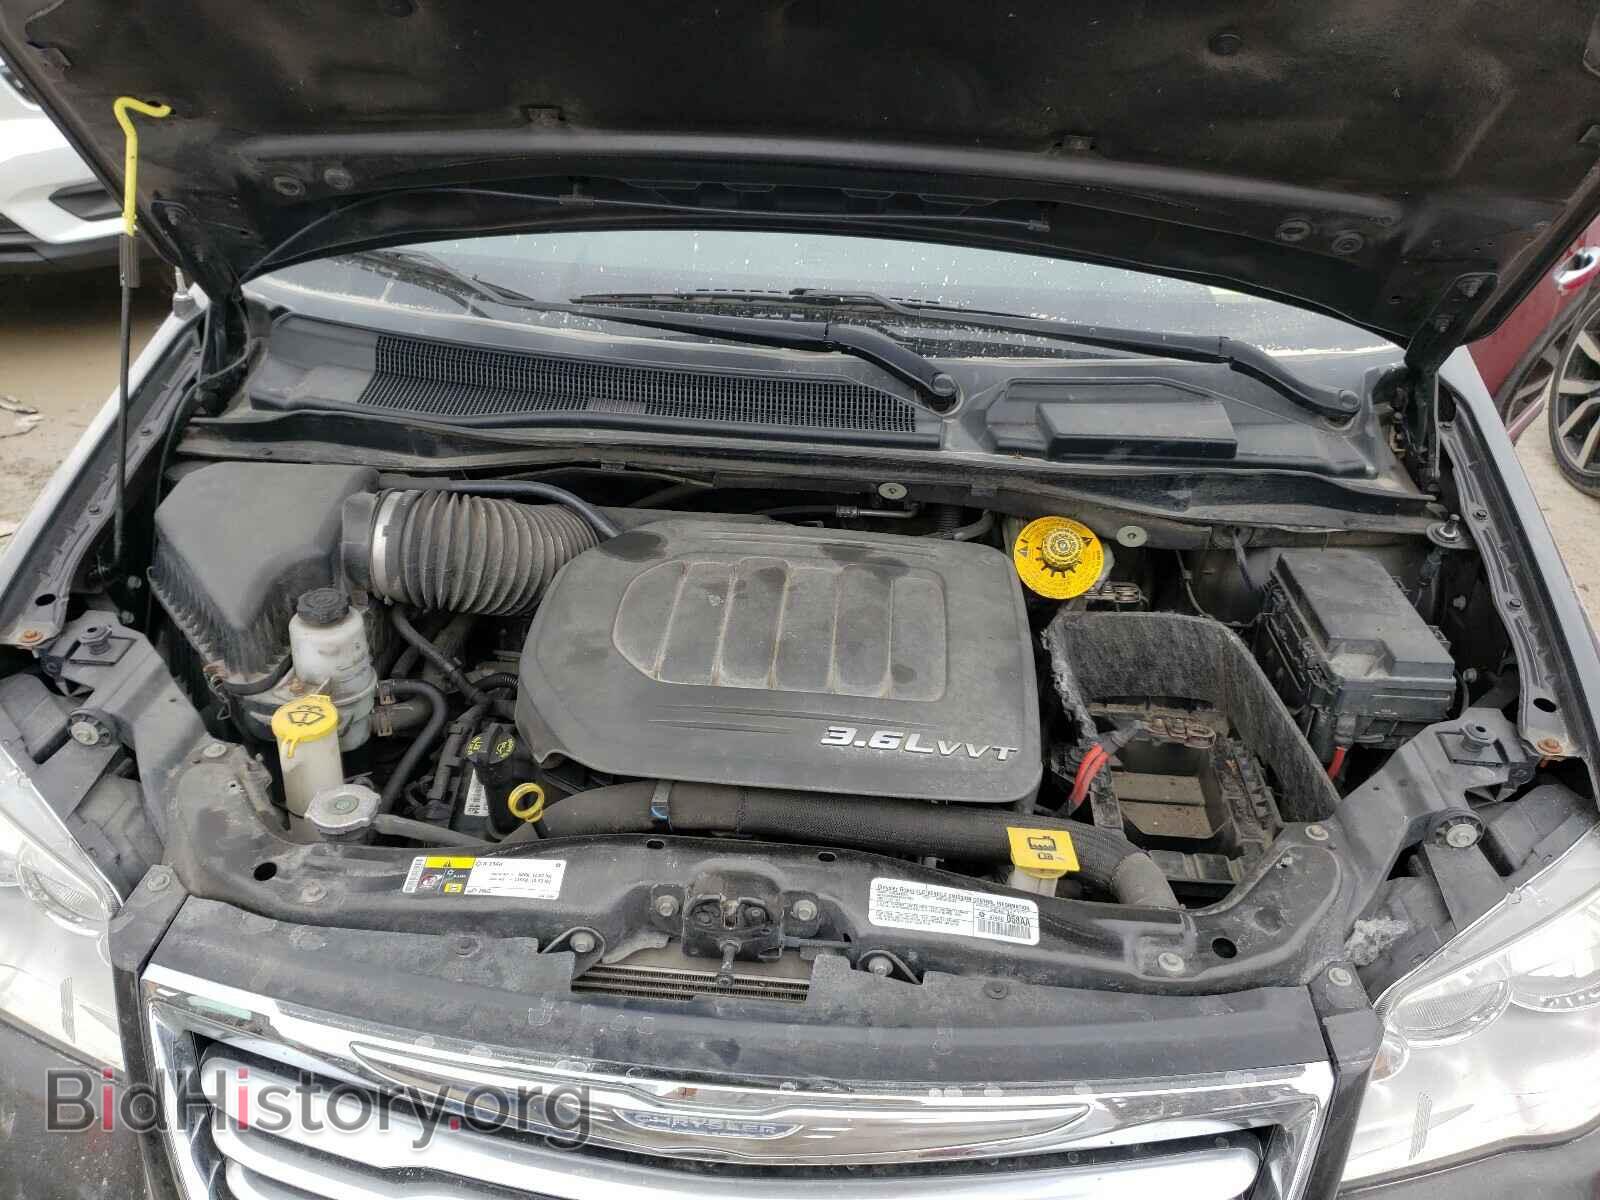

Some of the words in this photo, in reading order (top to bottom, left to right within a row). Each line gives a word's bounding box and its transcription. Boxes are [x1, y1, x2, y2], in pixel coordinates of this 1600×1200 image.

[820, 726, 934, 753] 3.6L
[937, 740, 1018, 761] VVT
[633, 1113, 777, 1135] CHRYSLER
